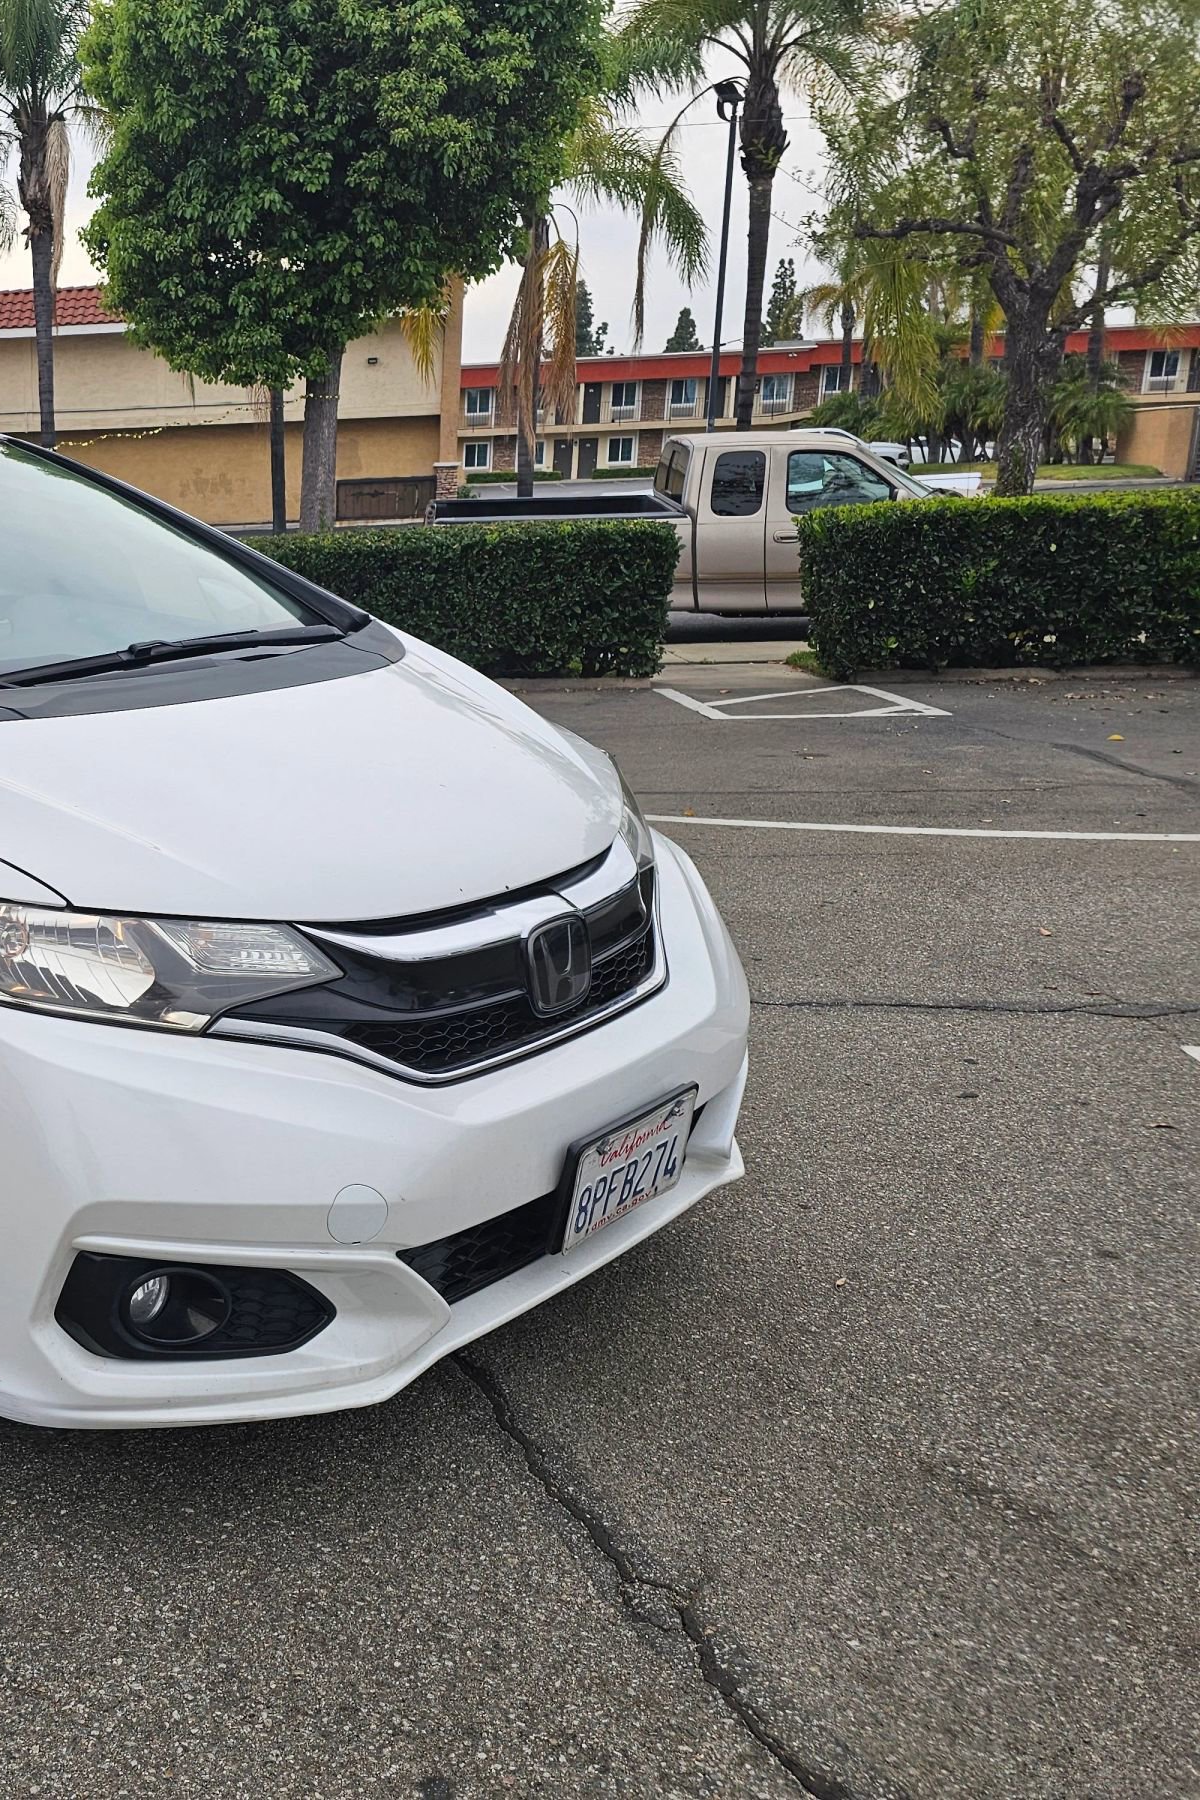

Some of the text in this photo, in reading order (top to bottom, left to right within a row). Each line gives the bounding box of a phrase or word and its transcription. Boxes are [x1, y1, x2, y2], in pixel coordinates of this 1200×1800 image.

[601, 1120, 672, 1167] California
[574, 1135, 678, 1234] 8PFB274
[592, 1191, 652, 1231] dmv.ca.gov
